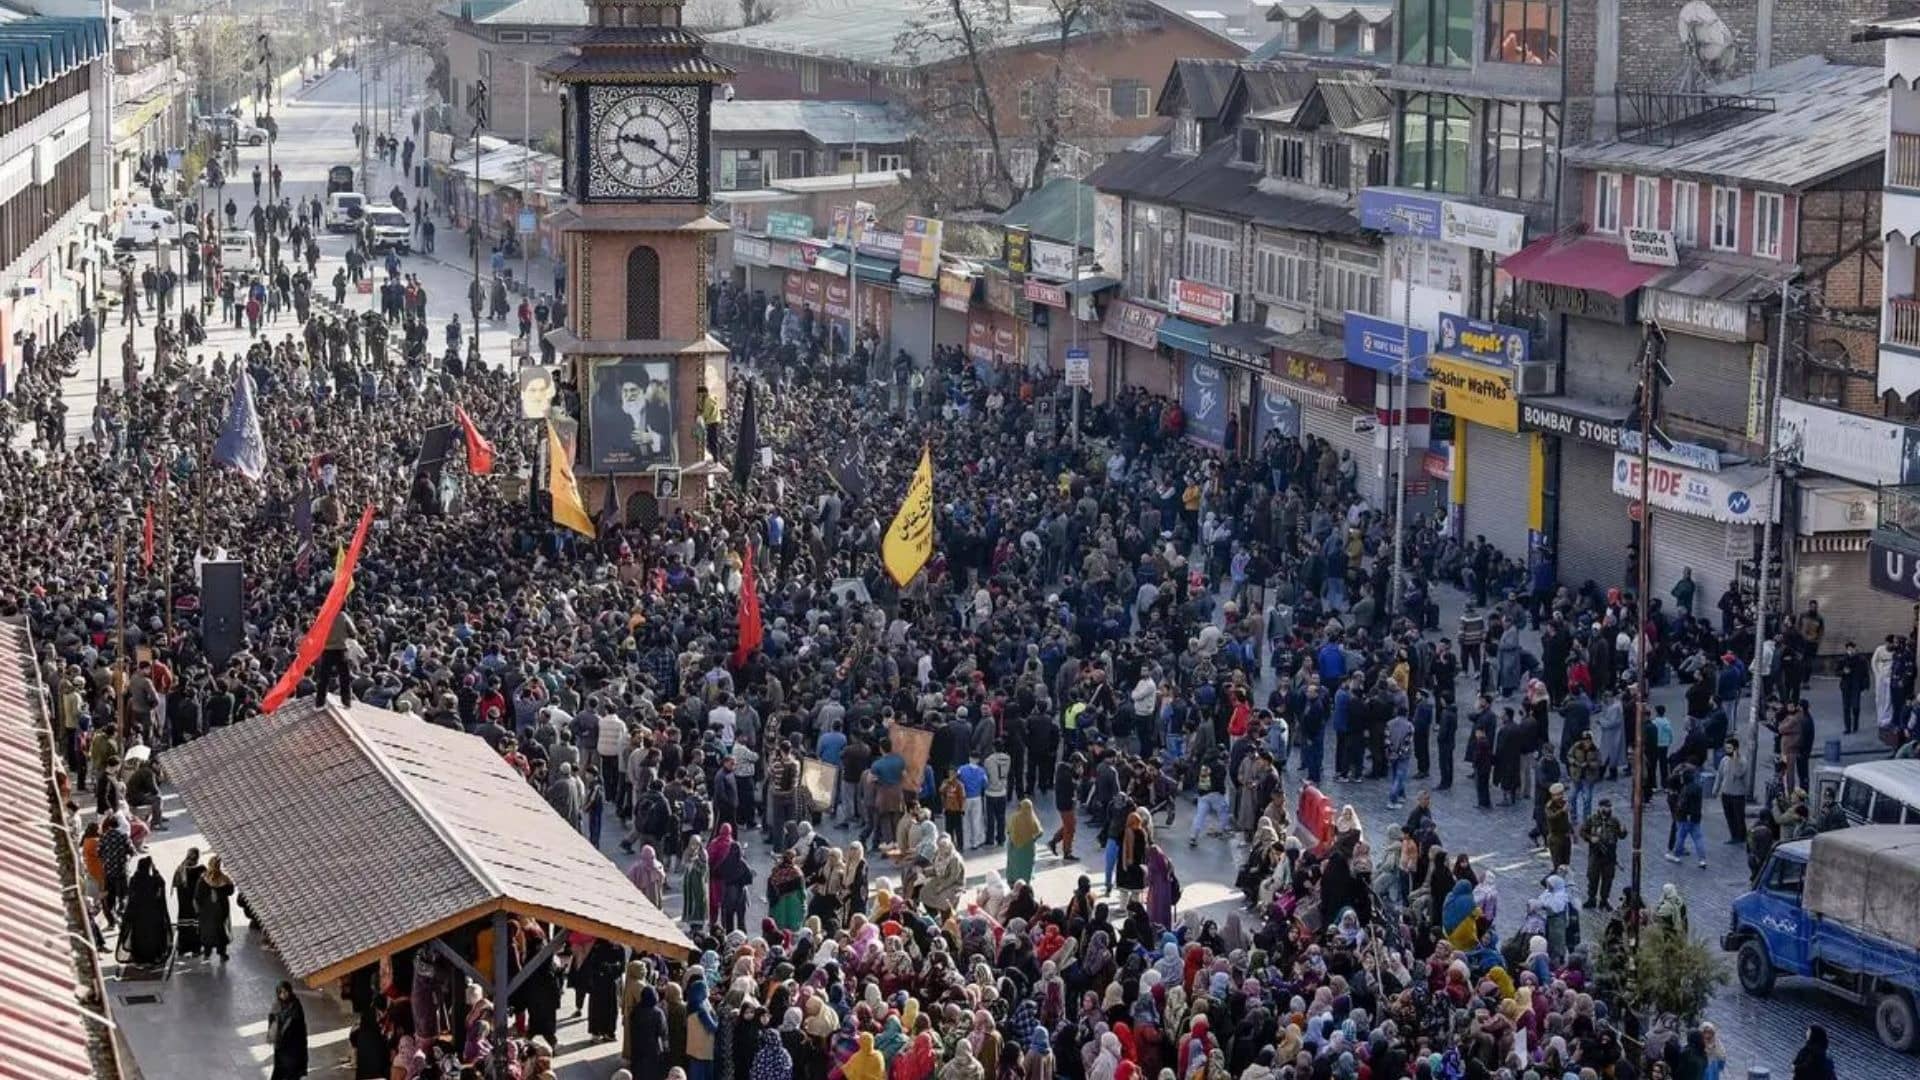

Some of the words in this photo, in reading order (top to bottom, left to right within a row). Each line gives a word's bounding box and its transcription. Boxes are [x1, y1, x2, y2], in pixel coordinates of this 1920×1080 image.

[1632, 243, 1668, 257] SUPPLIERS
[1692, 300, 1746, 334] EMPORIUM
[1434, 369, 1467, 389] Kashir
[1468, 375, 1507, 400] Waffles
[1523, 406, 1574, 433] BOMBAY
[1886, 551, 1904, 581] U
